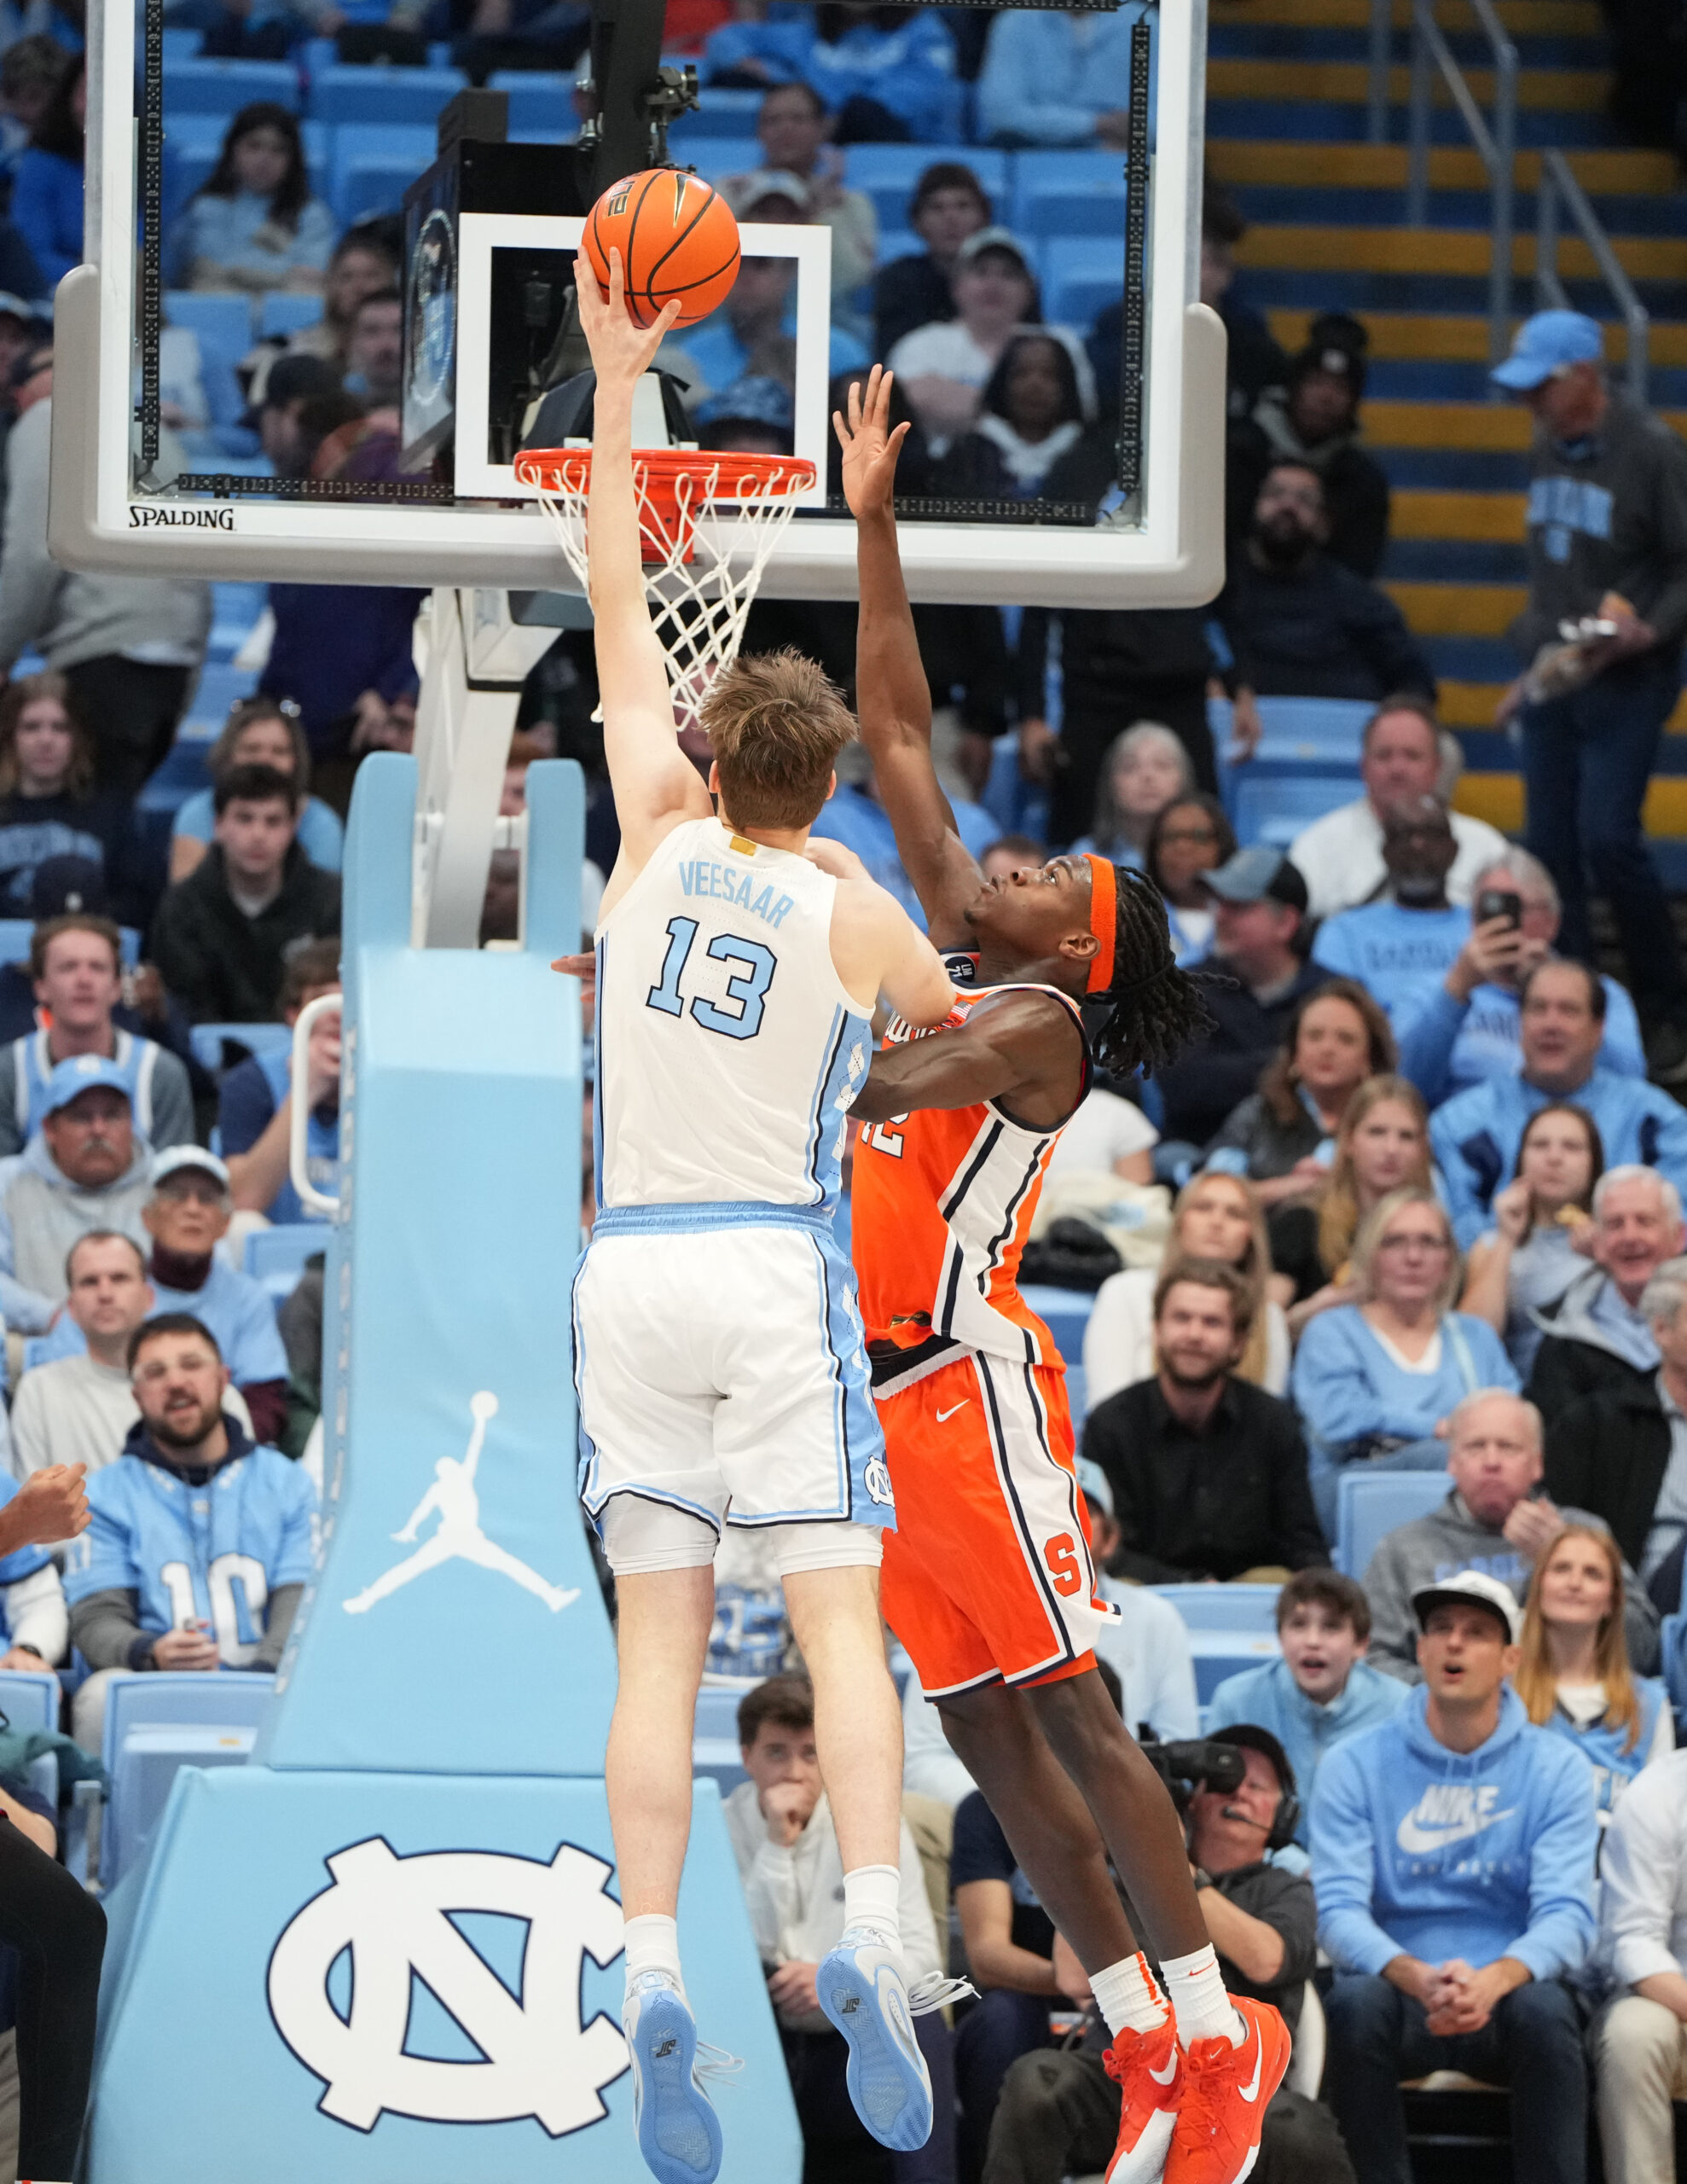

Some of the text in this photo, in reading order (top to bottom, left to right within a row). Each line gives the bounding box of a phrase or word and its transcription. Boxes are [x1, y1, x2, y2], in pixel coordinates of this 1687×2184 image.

[129, 505, 234, 531] SPALDING
[679, 861, 795, 930] VEESAAR
[645, 915, 778, 1041] 13
[1043, 1531, 1082, 1598] S
[160, 1552, 268, 1666] 10
[1417, 1783, 1500, 1827] NIKE
